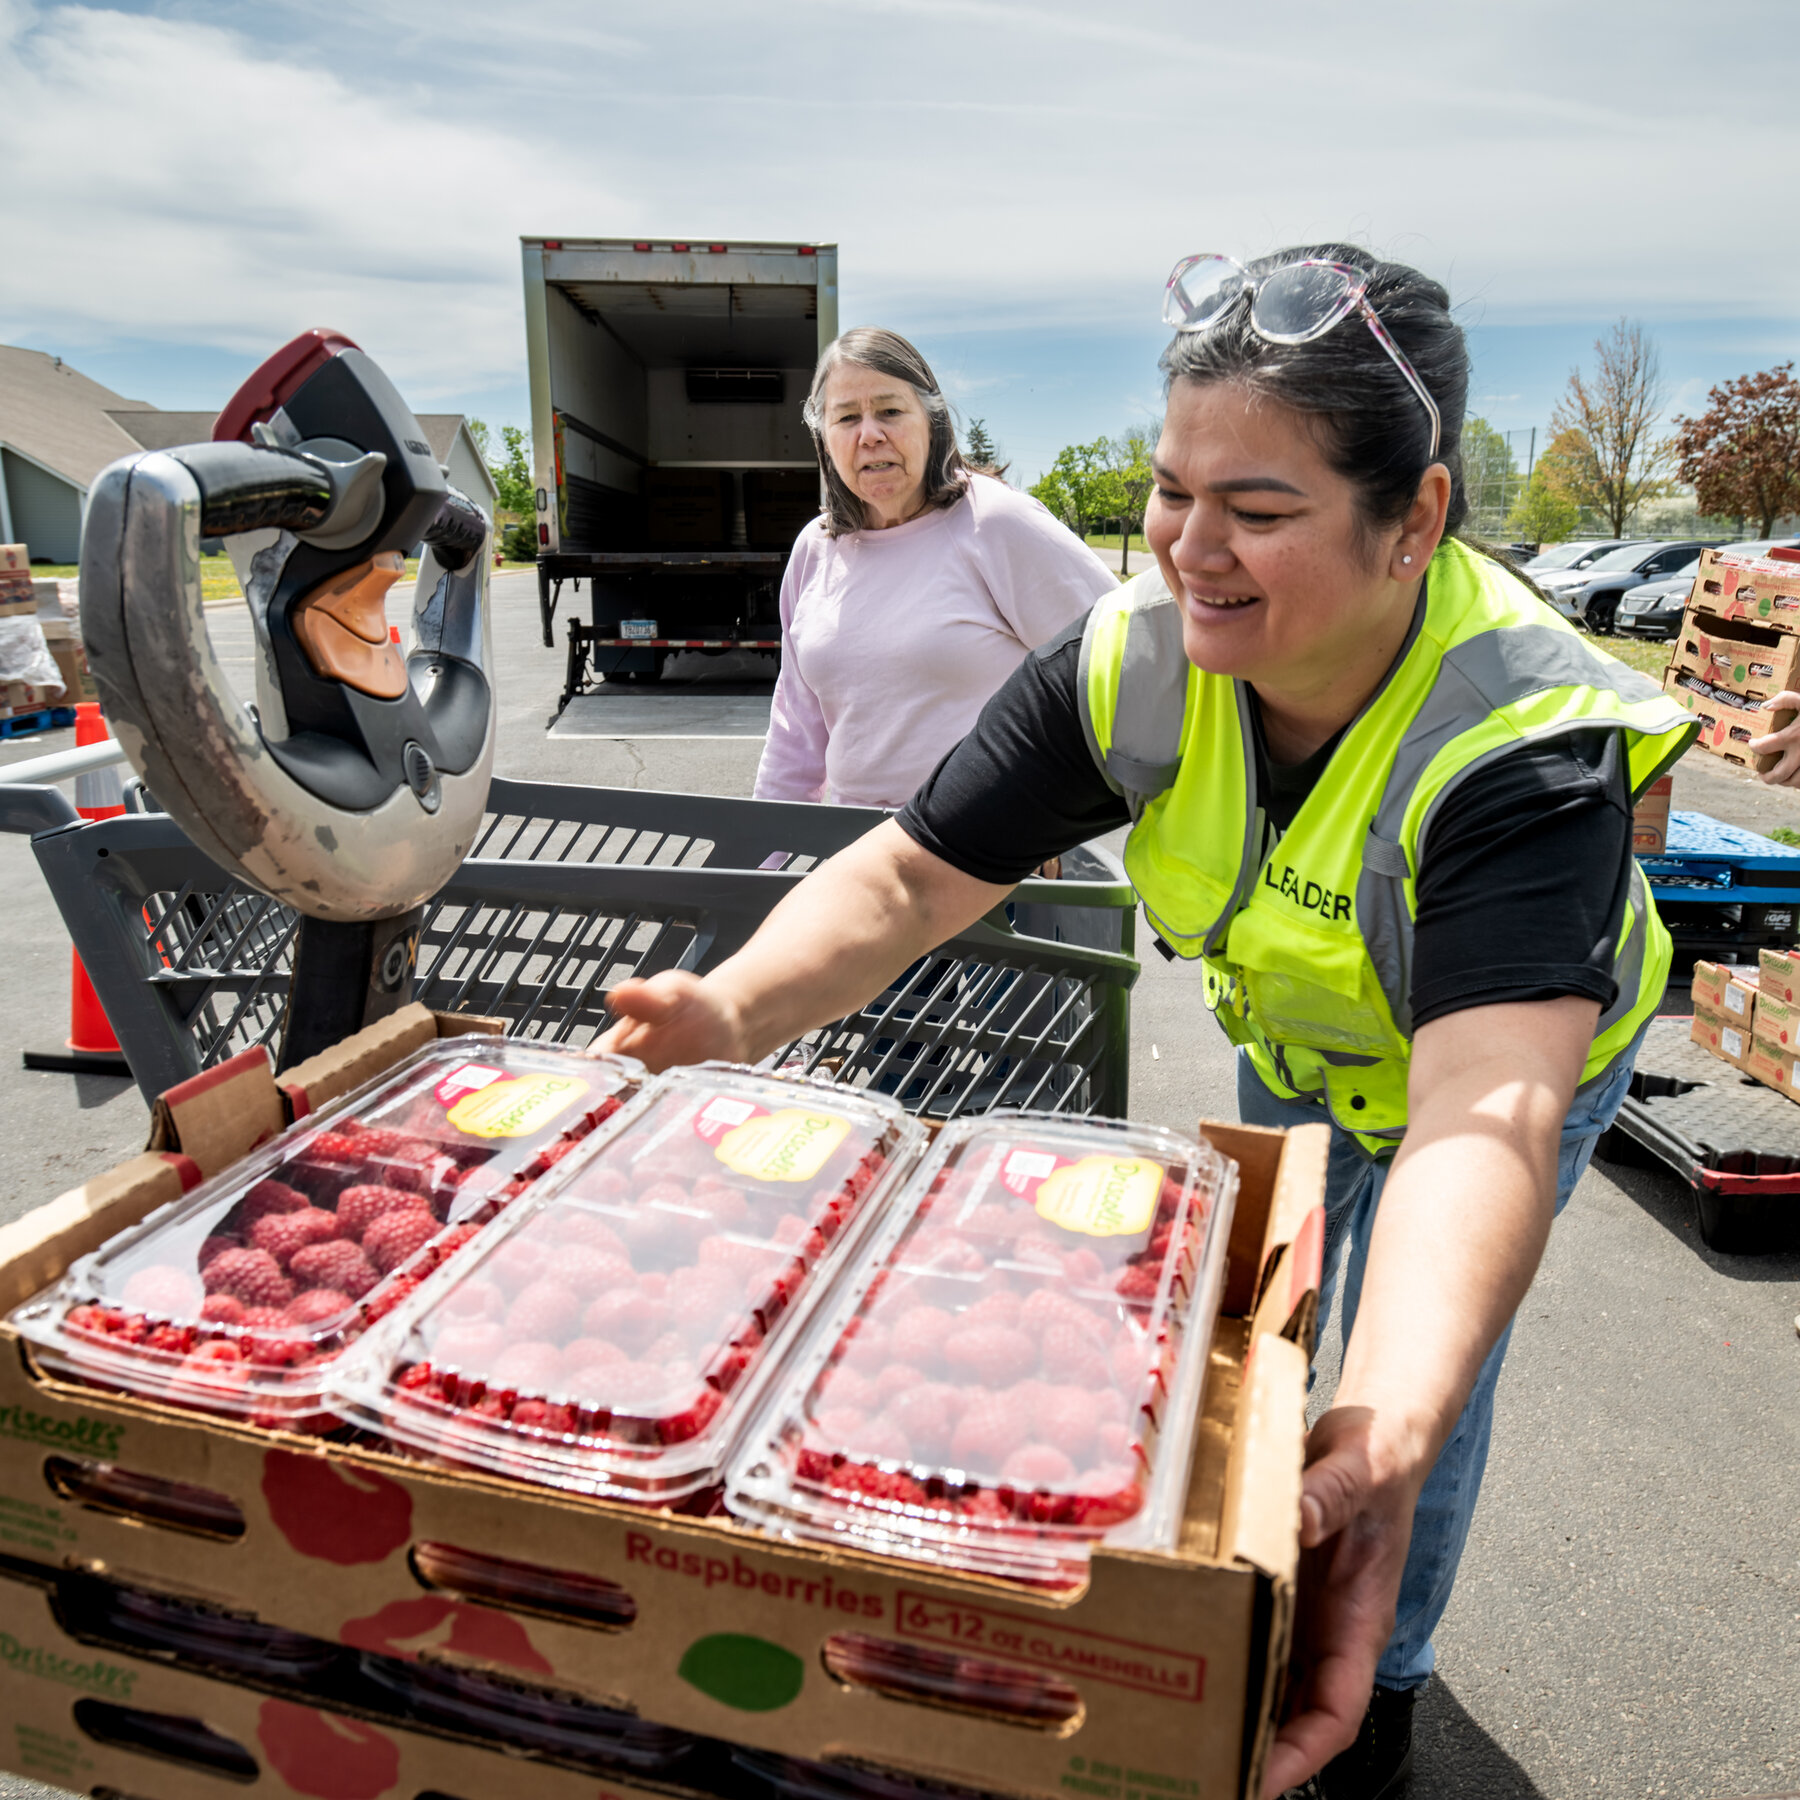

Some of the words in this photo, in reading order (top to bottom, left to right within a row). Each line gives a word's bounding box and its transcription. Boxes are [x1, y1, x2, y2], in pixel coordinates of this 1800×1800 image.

[1264, 862, 1352, 921] LEADER
[0, 1405, 126, 1452] riscoll's
[625, 1531, 885, 1619] Raspberries
[906, 1602, 985, 1644] 6-12
[1029, 1637, 1191, 1690] CLAMSHELLS
